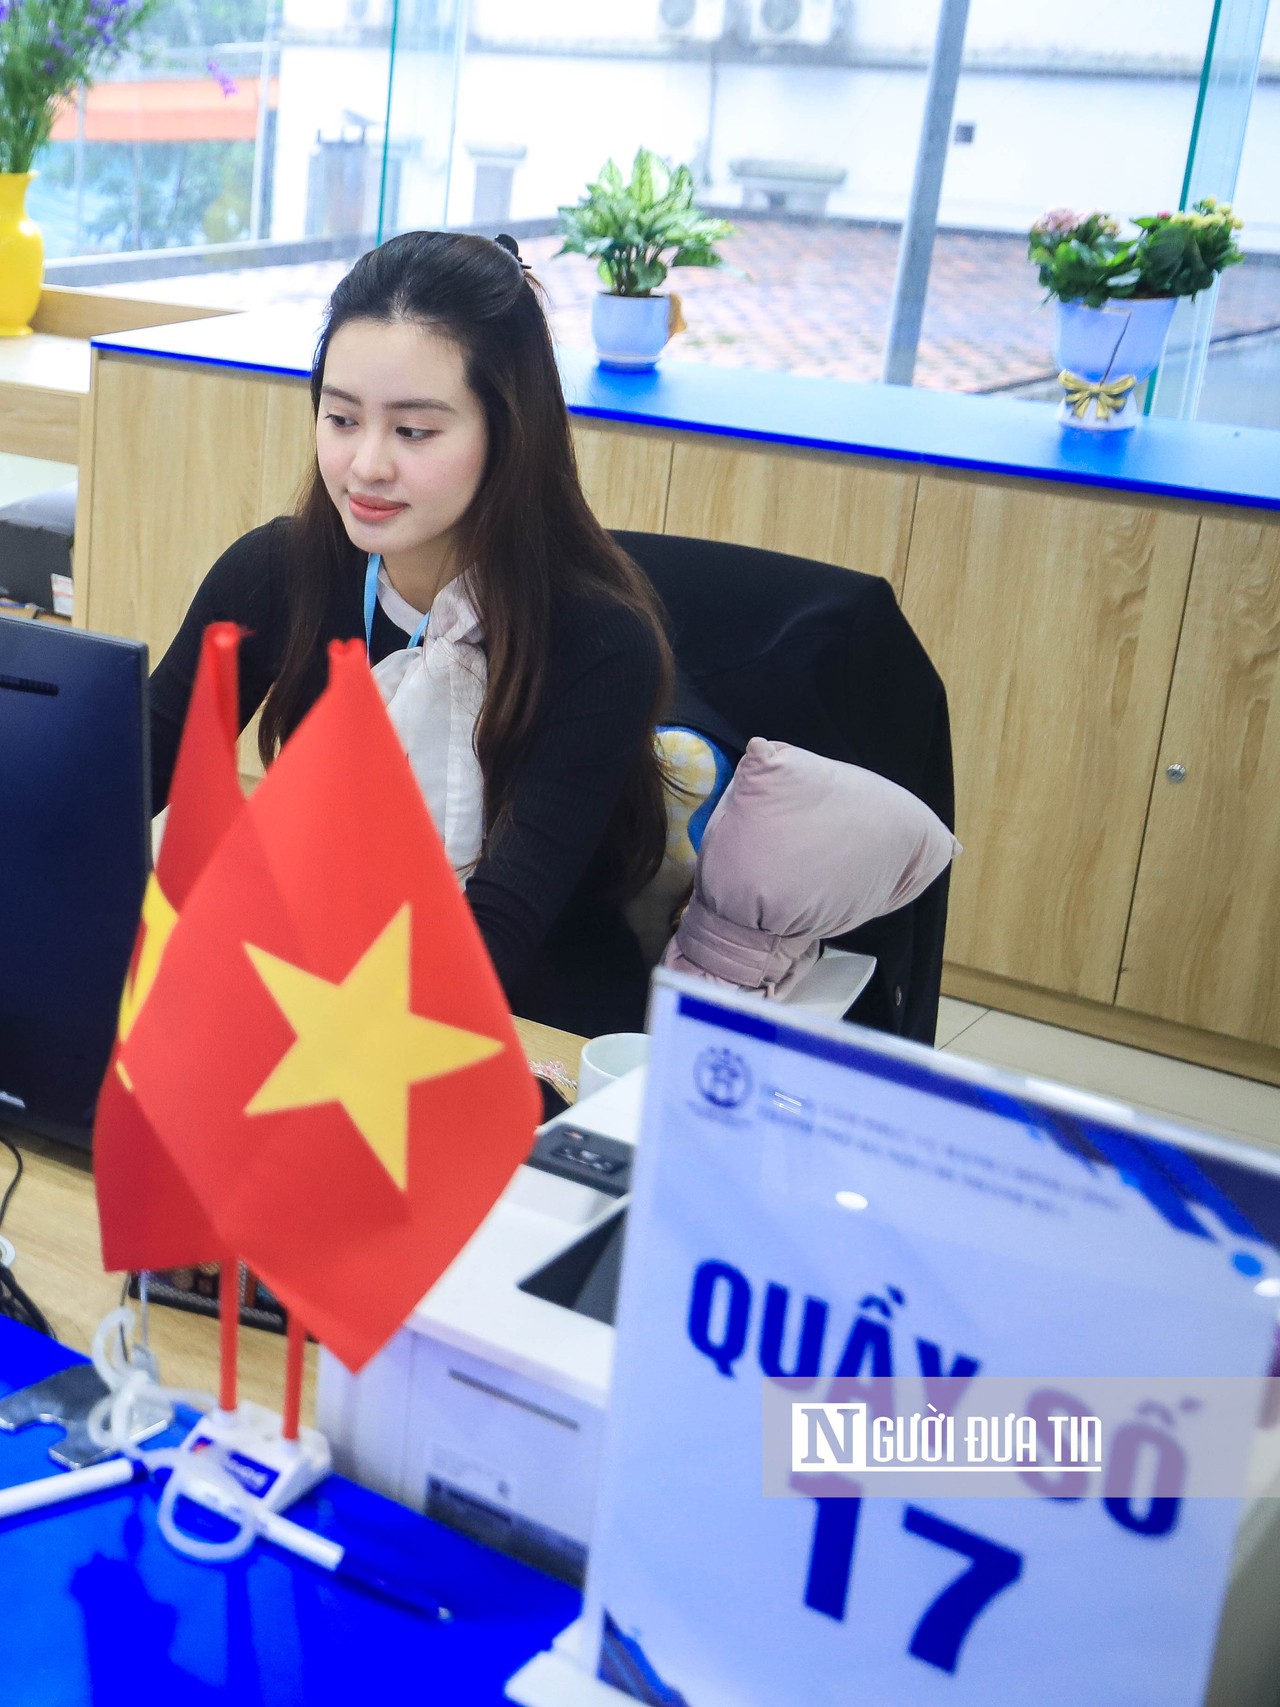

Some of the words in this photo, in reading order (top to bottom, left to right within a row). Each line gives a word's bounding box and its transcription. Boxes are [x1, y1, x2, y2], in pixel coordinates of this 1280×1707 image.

[686, 1258, 982, 1455] QUẦY
[1014, 1387, 1204, 1540] SỐ
[787, 1470, 1025, 1677] 17
